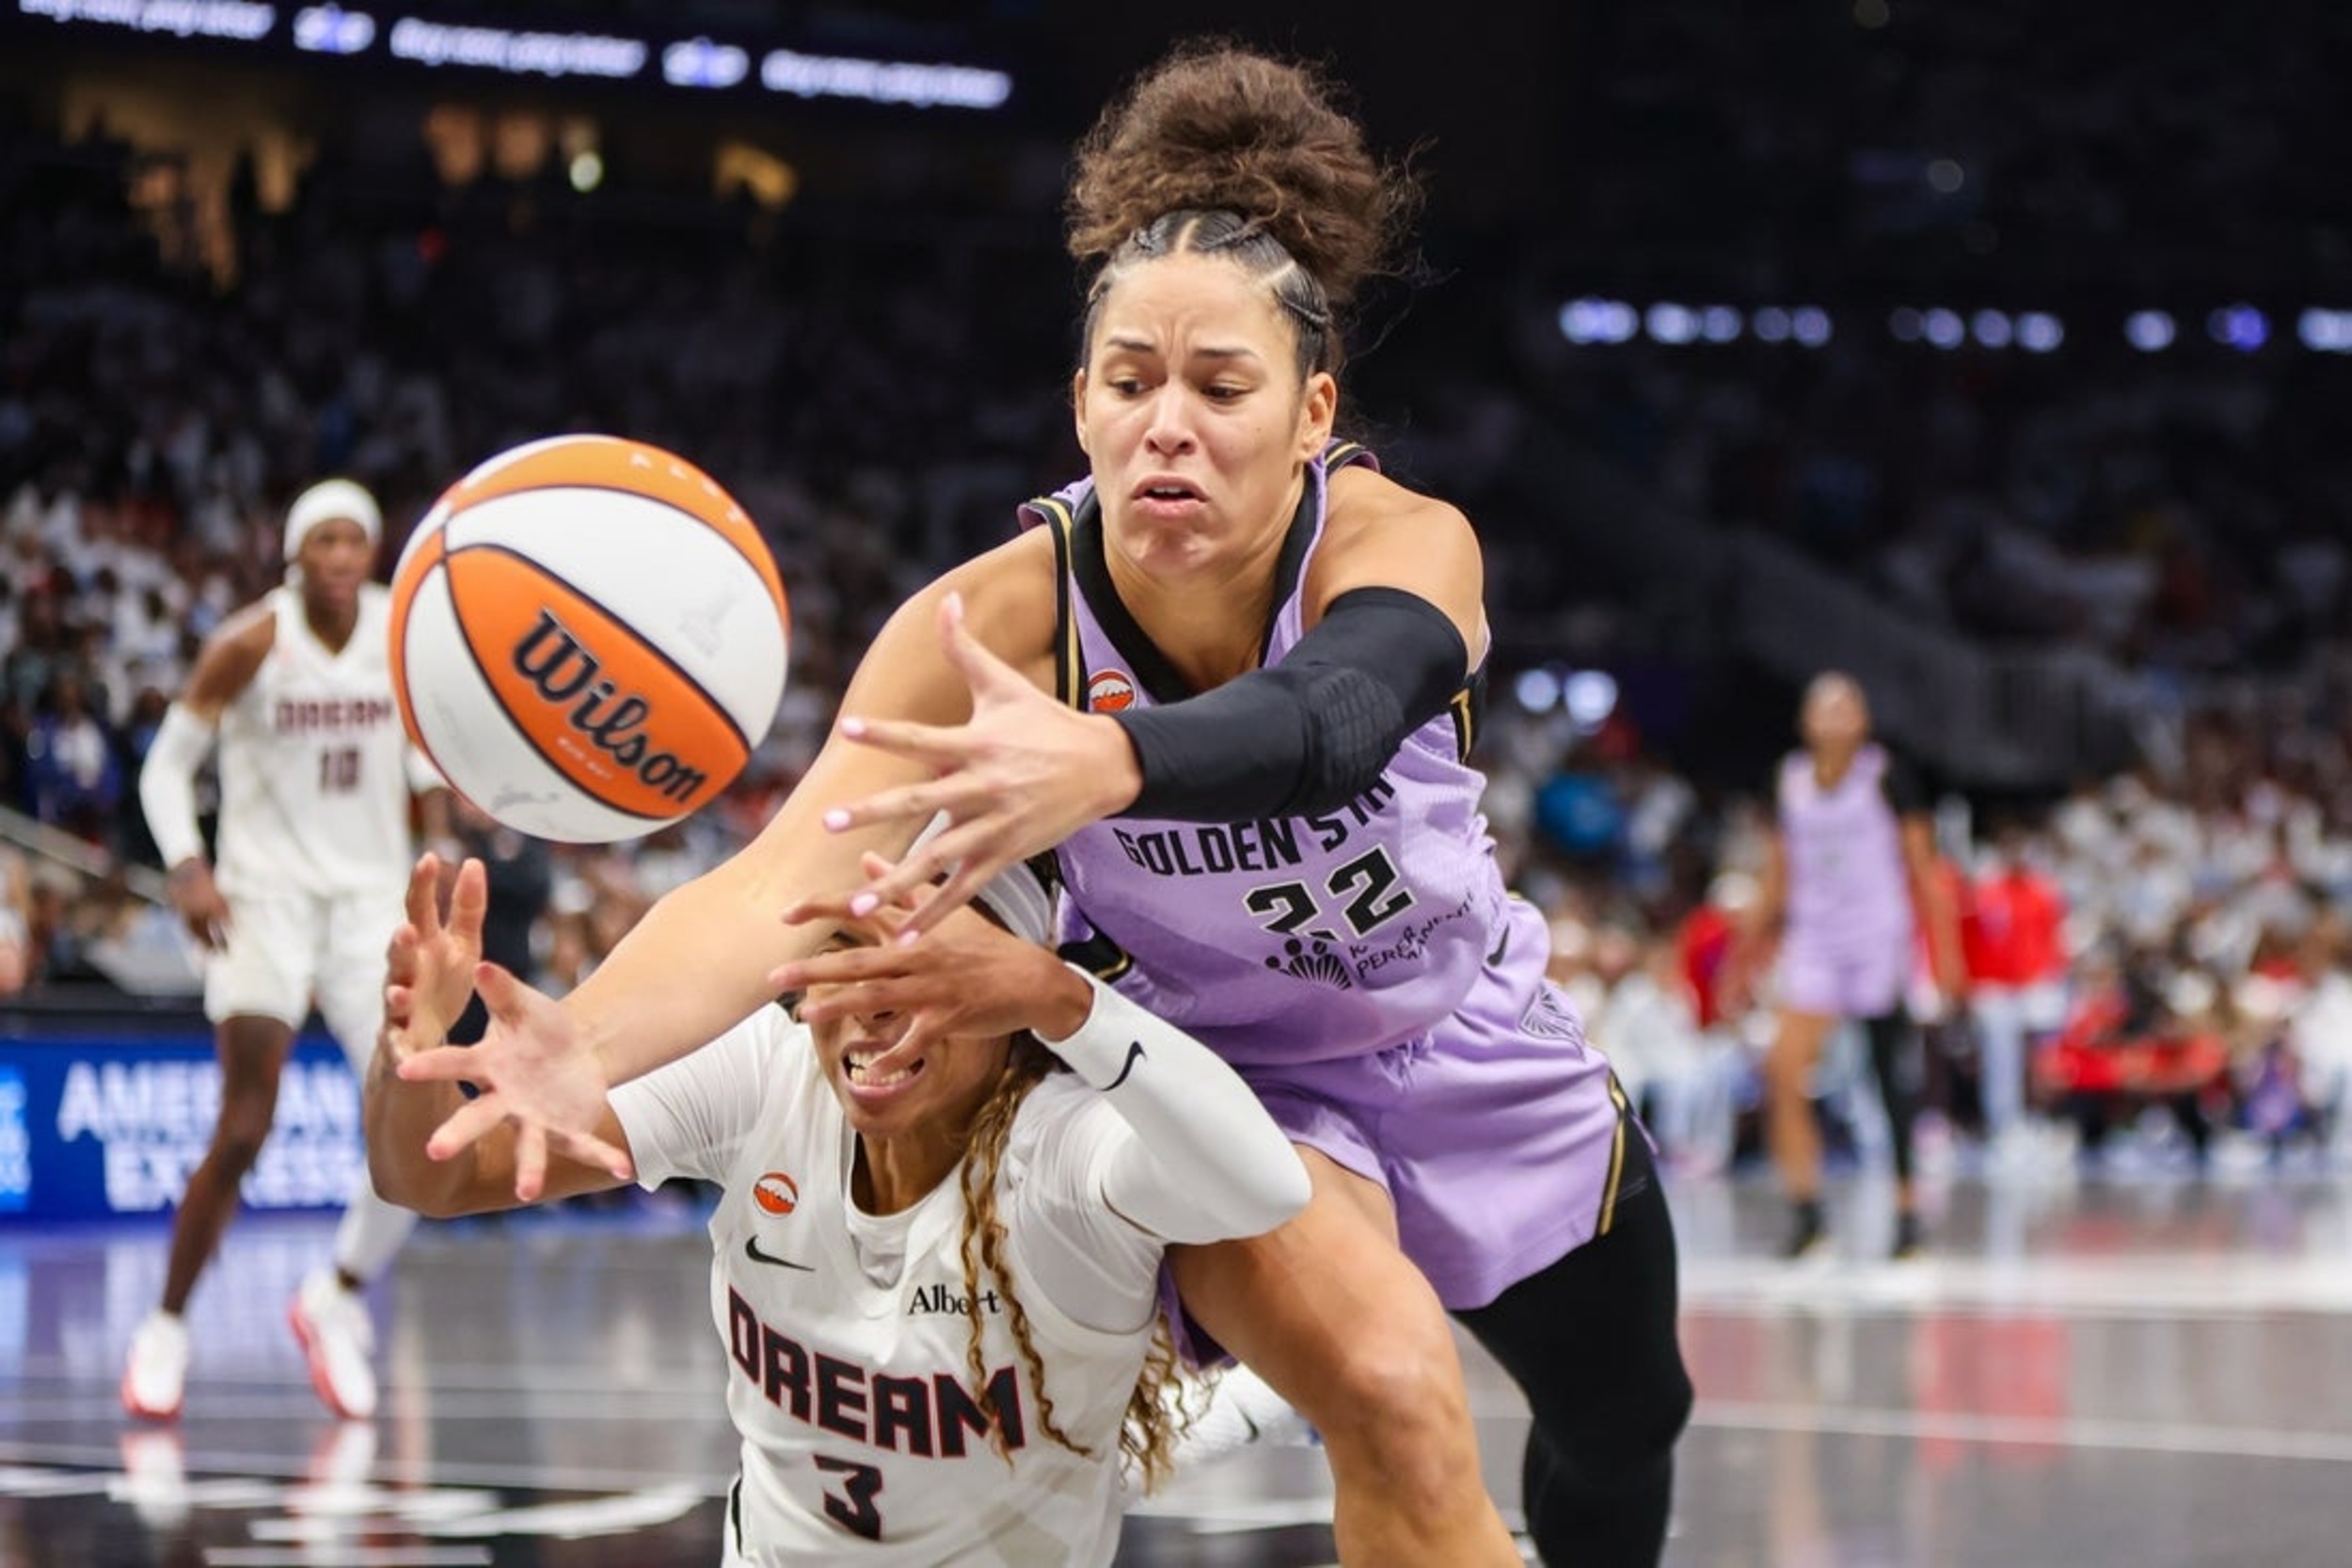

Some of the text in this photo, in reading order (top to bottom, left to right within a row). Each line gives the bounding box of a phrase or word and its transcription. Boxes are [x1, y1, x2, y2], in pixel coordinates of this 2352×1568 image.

[513, 607, 708, 804] Wilson
[1113, 815, 1302, 876] GOLDEN
[1242, 843, 1418, 942] 22
[728, 1283, 1026, 1459] DREAM
[813, 1453, 883, 1543] 3
